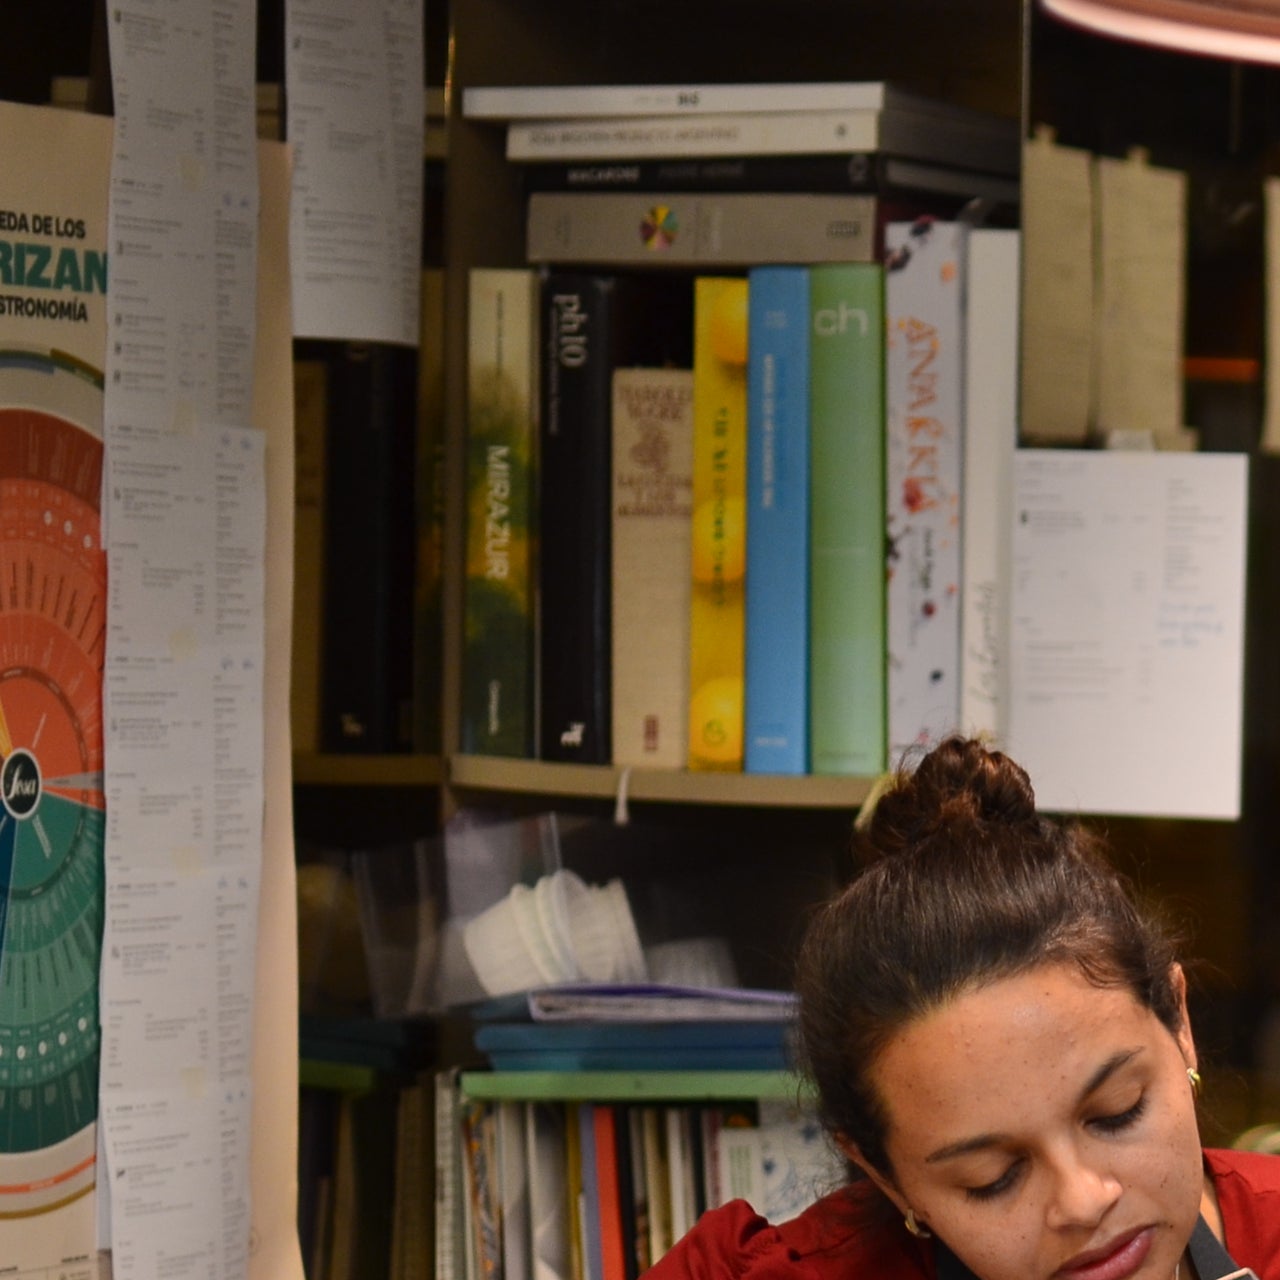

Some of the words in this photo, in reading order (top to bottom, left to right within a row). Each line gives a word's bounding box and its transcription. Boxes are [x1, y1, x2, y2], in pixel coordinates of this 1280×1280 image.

[32, 214, 53, 236] DE
[56, 217, 86, 239] LOS
[814, 302, 869, 337] ch
[486, 446, 511, 579] MIRAZUR
